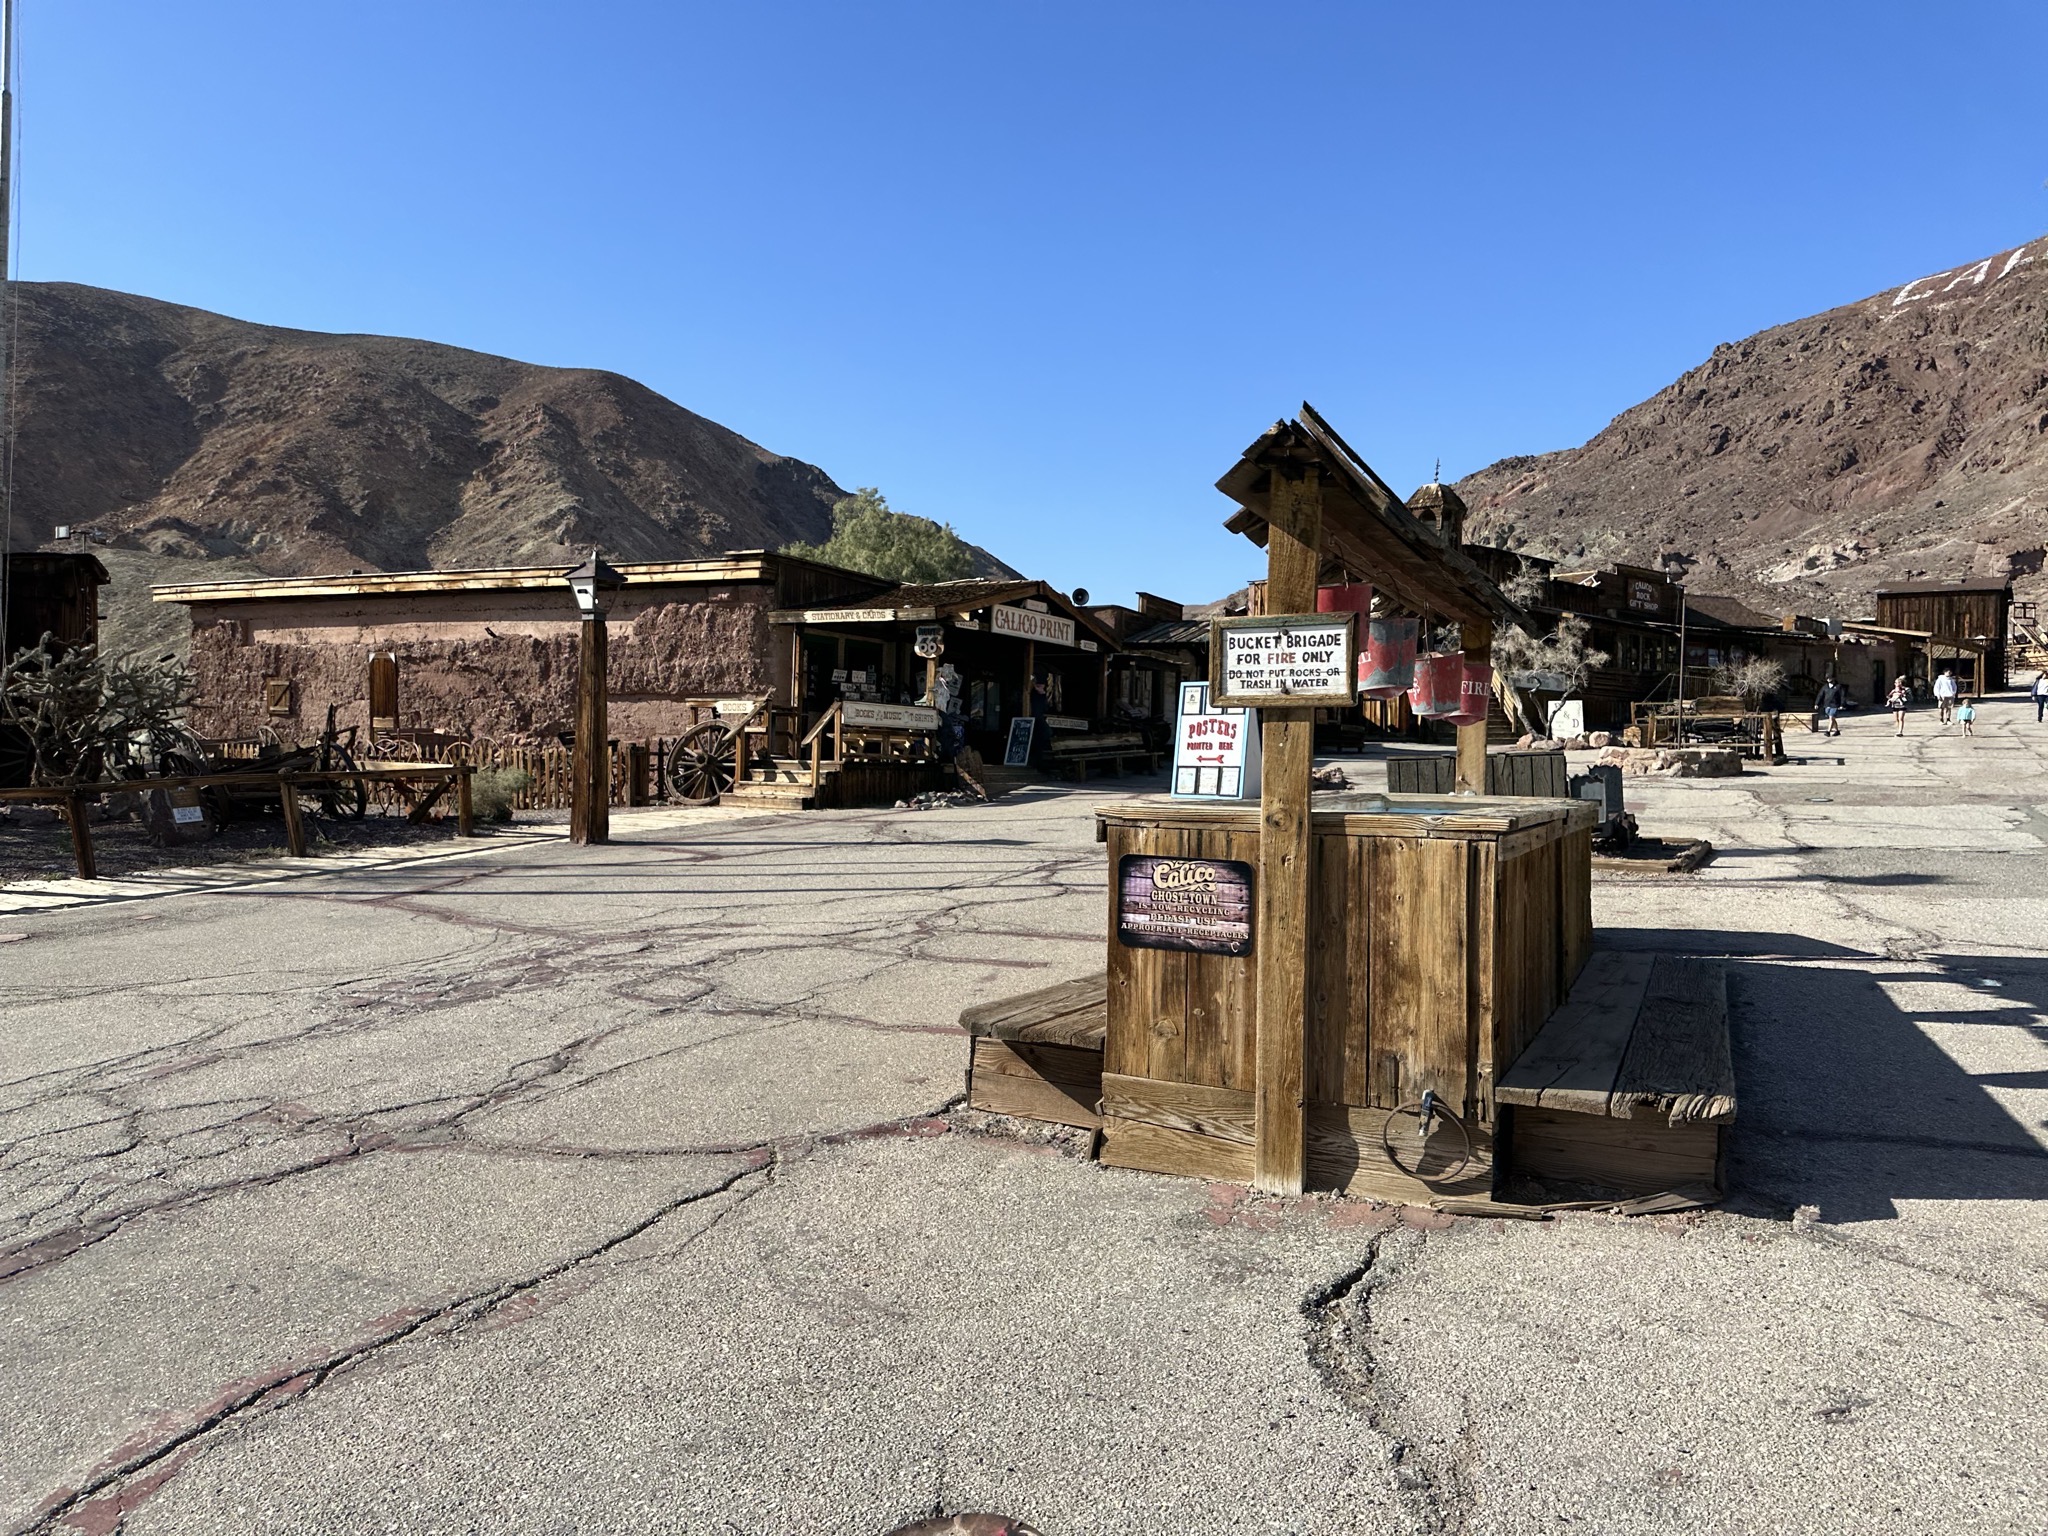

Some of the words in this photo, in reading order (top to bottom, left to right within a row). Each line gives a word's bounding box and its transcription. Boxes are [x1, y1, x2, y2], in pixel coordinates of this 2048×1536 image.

[1635, 582, 1652, 592] CALICO
[1636, 592, 1650, 600] ROCK
[1630, 600, 1641, 608] GIFT
[1644, 602, 1658, 610] SHOP
[811, 612, 855, 621] STATIONARY
[862, 611, 886, 619] CARDS
[995, 608, 1037, 635] CALICO
[1039, 618, 1071, 641] PRINT
[920, 637, 938, 654] 66
[1228, 635, 1280, 650] BUCKET
[1286, 634, 1342, 649] BRIGADE
[1236, 653, 1261, 665] FOR
[1267, 652, 1297, 665] FIRE
[1302, 650, 1335, 663] ONLY
[1228, 669, 1243, 680] DO
[1246, 669, 1265, 679] NOT
[1268, 669, 1286, 678] PUT
[1289, 668, 1321, 677] ROCKS
[1326, 667, 1340, 676] OR
[1240, 679, 1272, 689] TRASH
[1275, 679, 1287, 689] IN
[1291, 678, 1329, 688] WATER
[1461, 680, 1490, 696] FIRE
[722, 703, 747, 712] BOOKS
[854, 708, 875, 719] BOOKS
[883, 710, 902, 721] MUSIC
[1188, 718, 1238, 739] POSTERS
[1572, 718, 1580, 728] D
[1186, 741, 1213, 751] PRINTED
[1218, 741, 1234, 751] HERE
[1152, 860, 1217, 890] Calico
[1151, 890, 1185, 903] GHOST
[1187, 892, 1218, 905] TOWN
[1151, 903, 1172, 911] NOW
[1177, 905, 1230, 916] RECYCLING
[1150, 913, 1192, 924] PLEASE
[1196, 916, 1218, 926] USE
[1120, 921, 1182, 934] APPROPRIATE
[1187, 927, 1249, 940] RECEPTACLES
